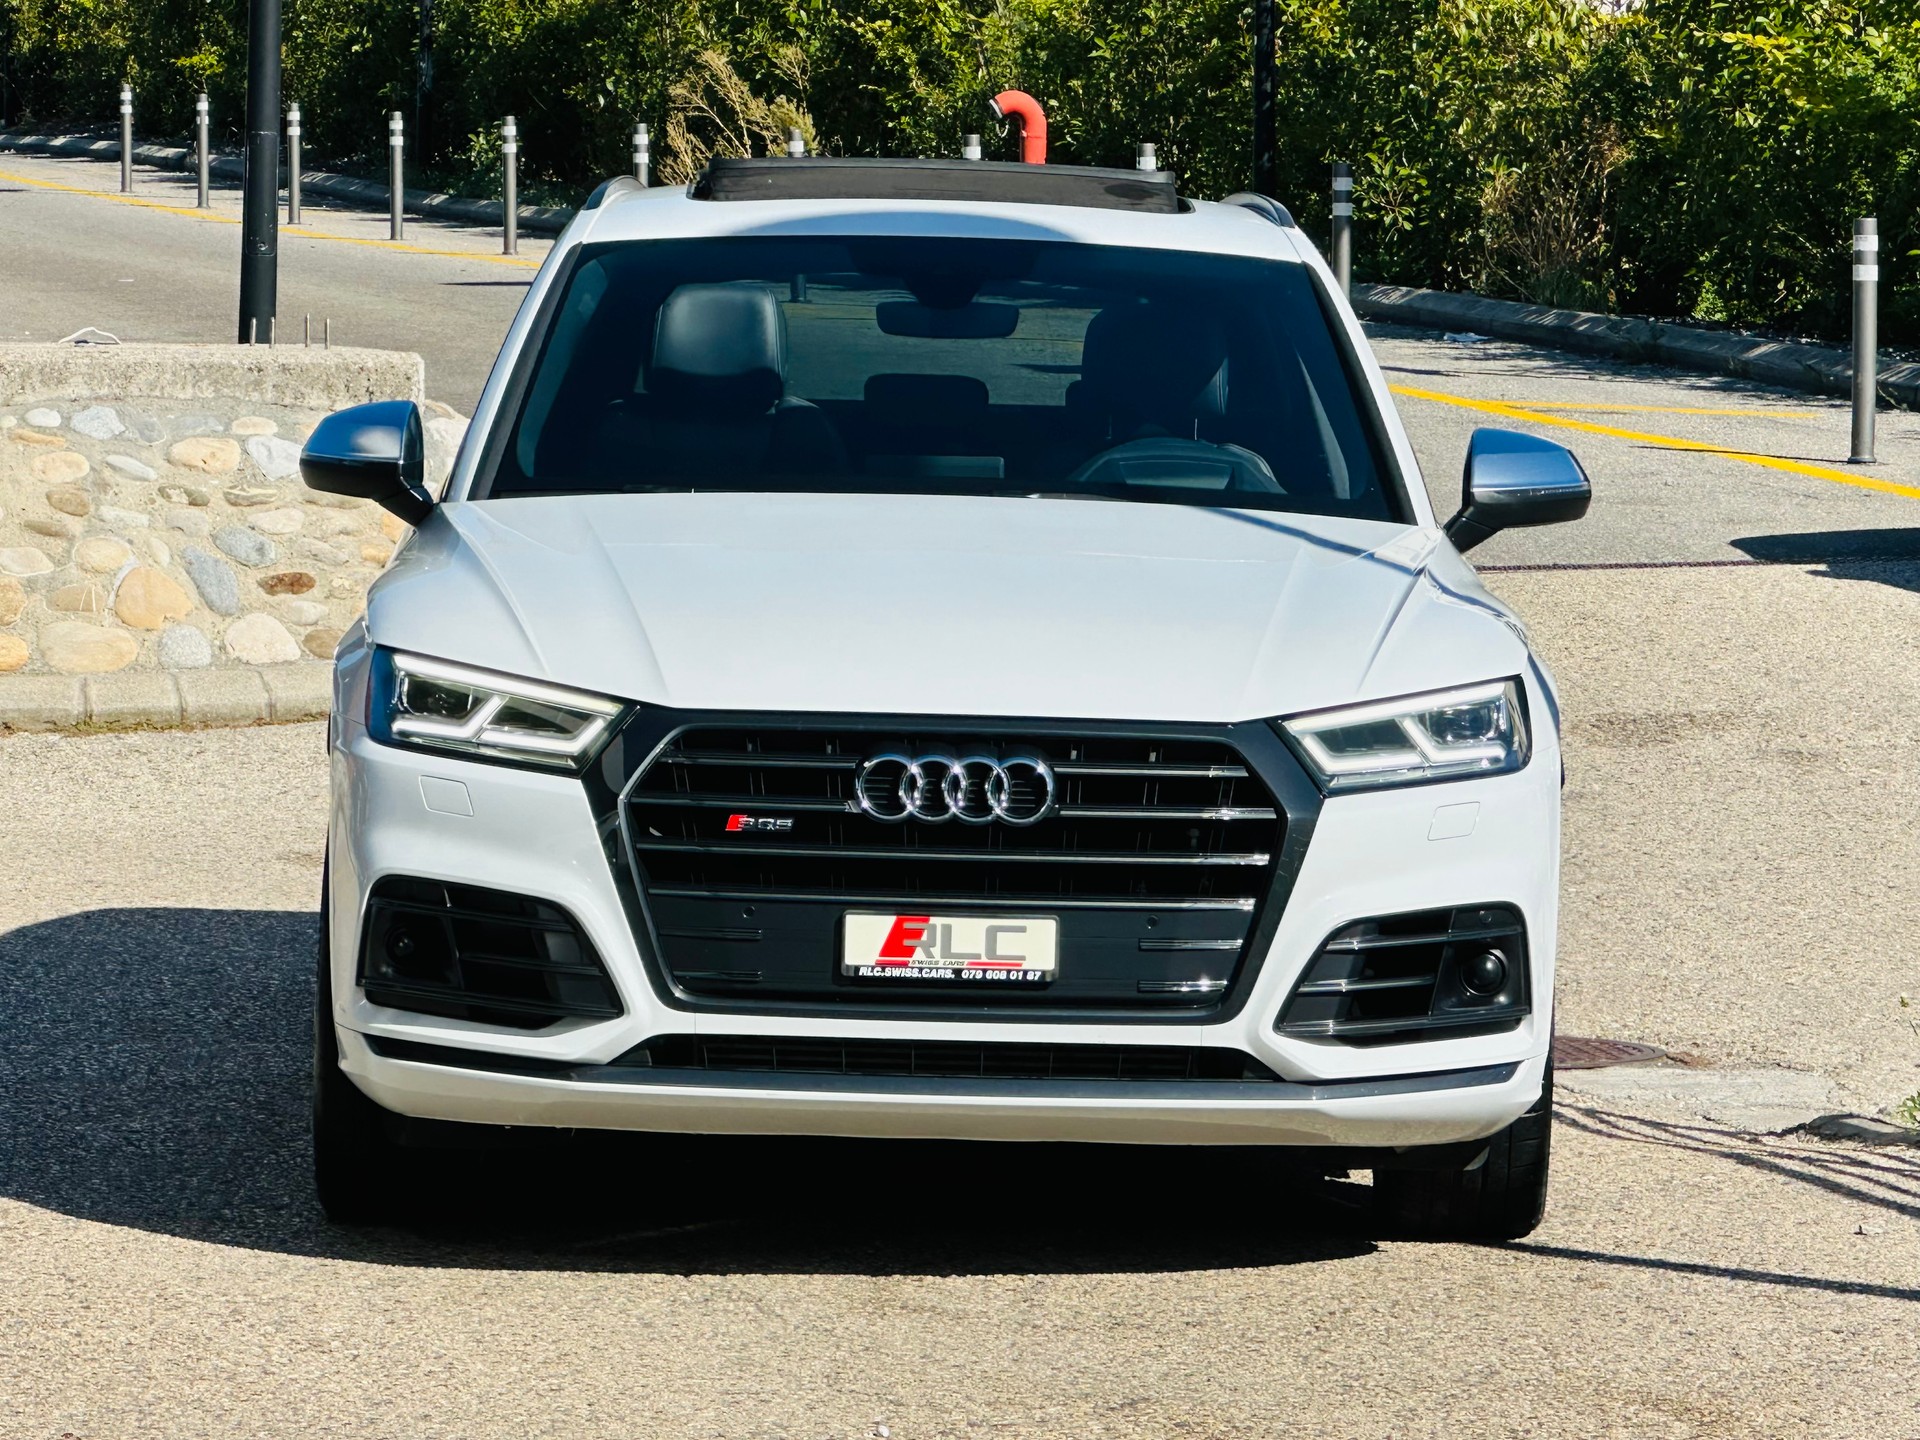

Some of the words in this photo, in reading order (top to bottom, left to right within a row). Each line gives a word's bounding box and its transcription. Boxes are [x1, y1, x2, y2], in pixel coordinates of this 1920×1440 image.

[903, 923, 1027, 961] RLC
[961, 969, 983, 979] 079
[1009, 970, 1023, 980] 01
